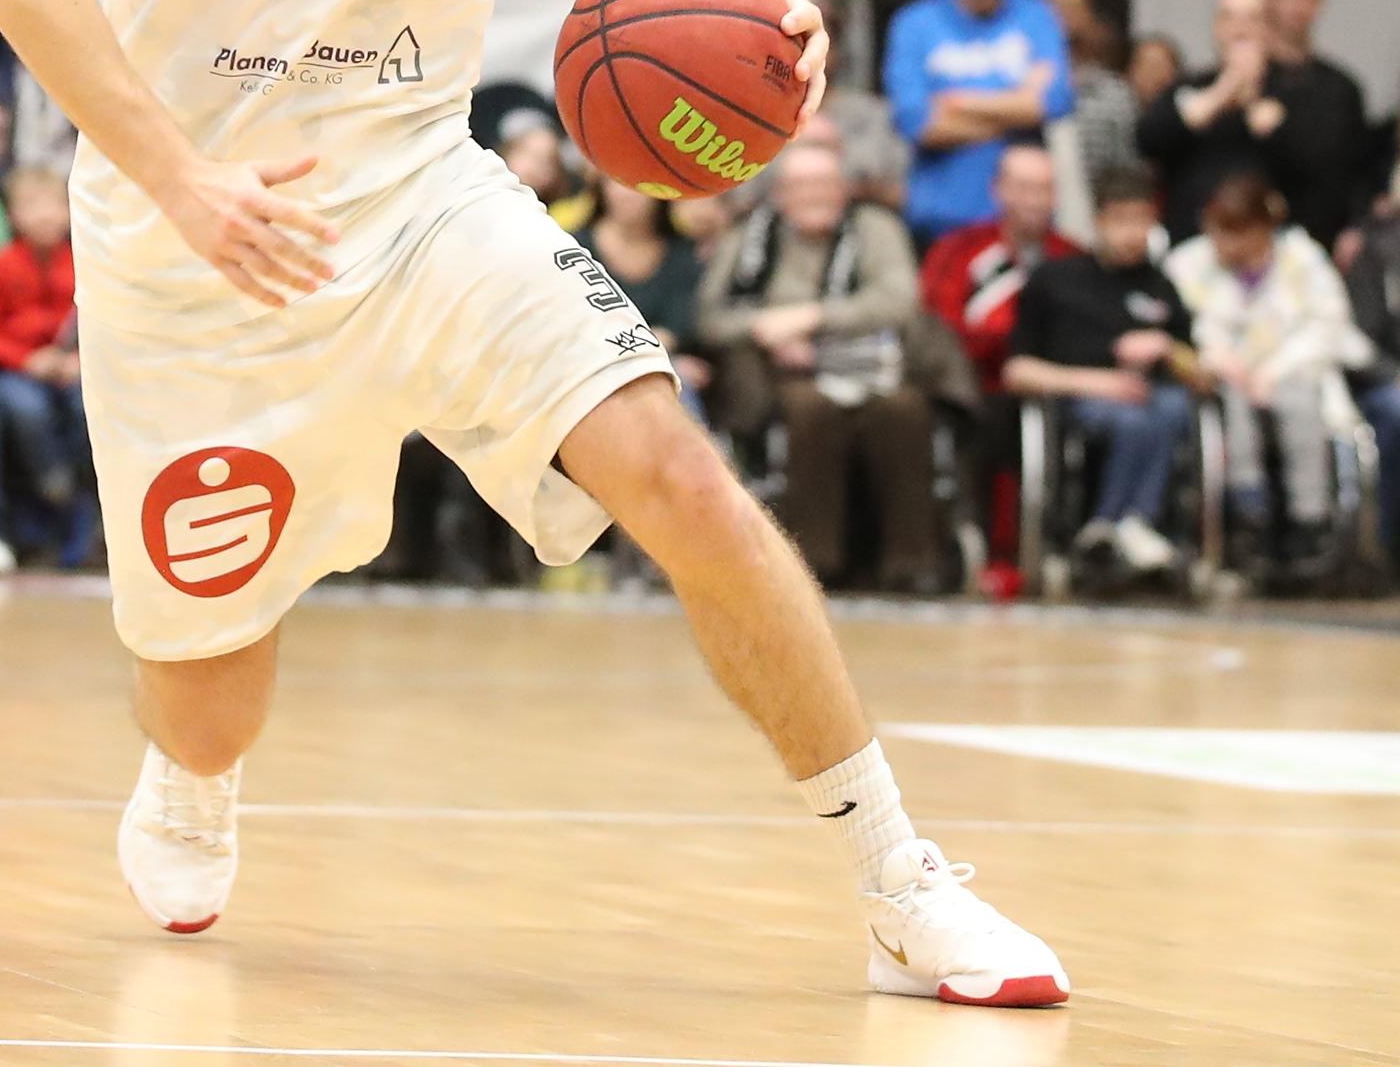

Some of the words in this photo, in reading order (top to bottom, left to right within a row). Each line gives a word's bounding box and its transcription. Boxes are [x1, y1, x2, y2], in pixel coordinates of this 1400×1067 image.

[213, 47, 289, 75] Planen
[764, 55, 792, 81] FIBA
[325, 72, 343, 85] KG
[659, 96, 768, 183] Wilso
[553, 247, 629, 312] 3
